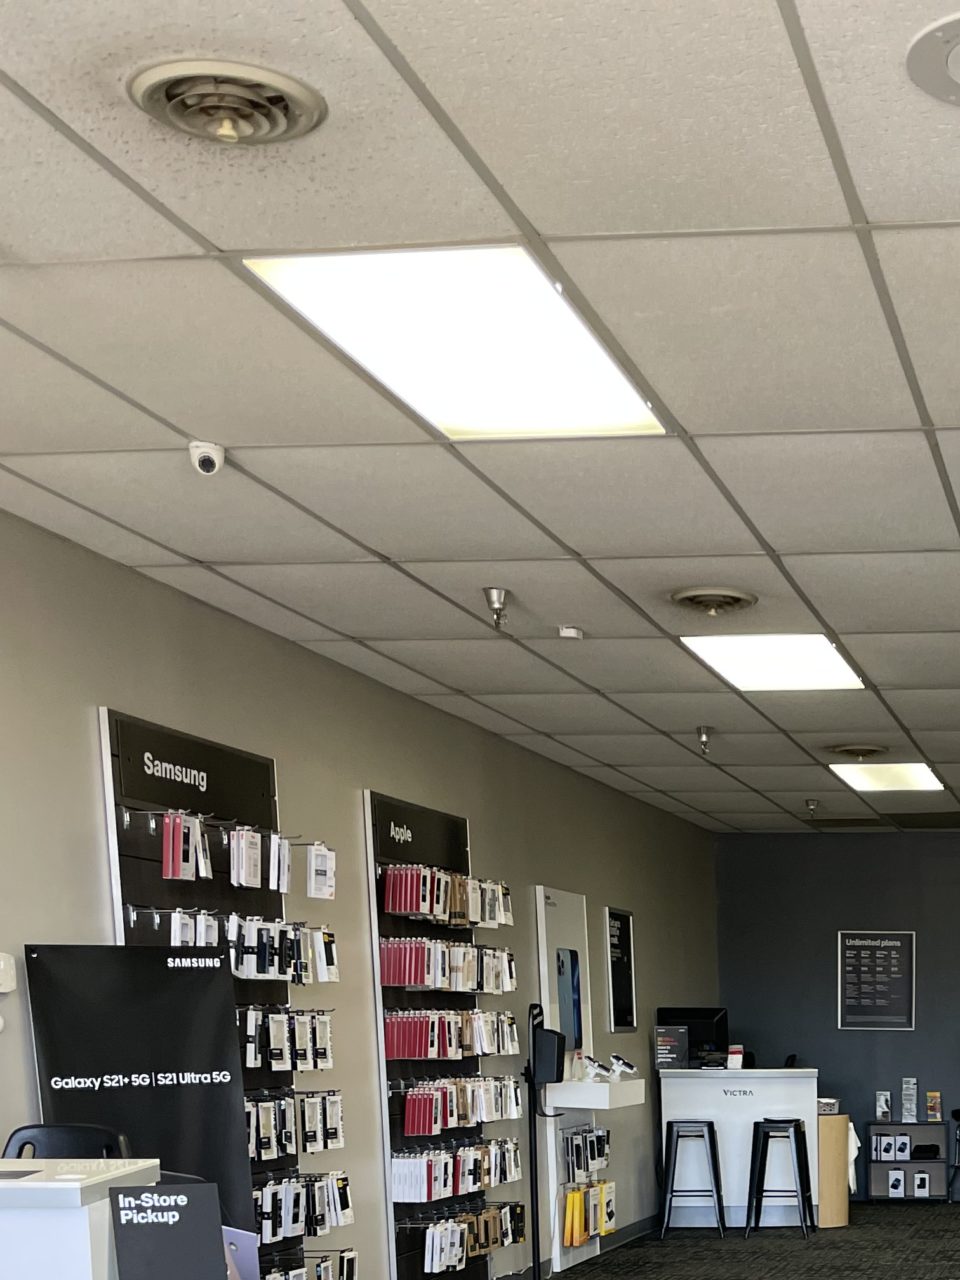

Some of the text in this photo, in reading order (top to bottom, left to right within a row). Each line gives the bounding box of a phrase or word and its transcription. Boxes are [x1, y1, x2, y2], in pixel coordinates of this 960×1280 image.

[143, 751, 208, 792] Samsung
[389, 821, 413, 843] Apple
[845, 938, 901, 948] Unlimited plans
[167, 957, 221, 968] SAMSUNG
[51, 1071, 231, 1090] Galaxy S21+ 5G S21 Ultra 5G
[723, 1088, 754, 1097] VICTRA
[118, 1192, 188, 1208] In-Store
[120, 1209, 180, 1225] Pickup
